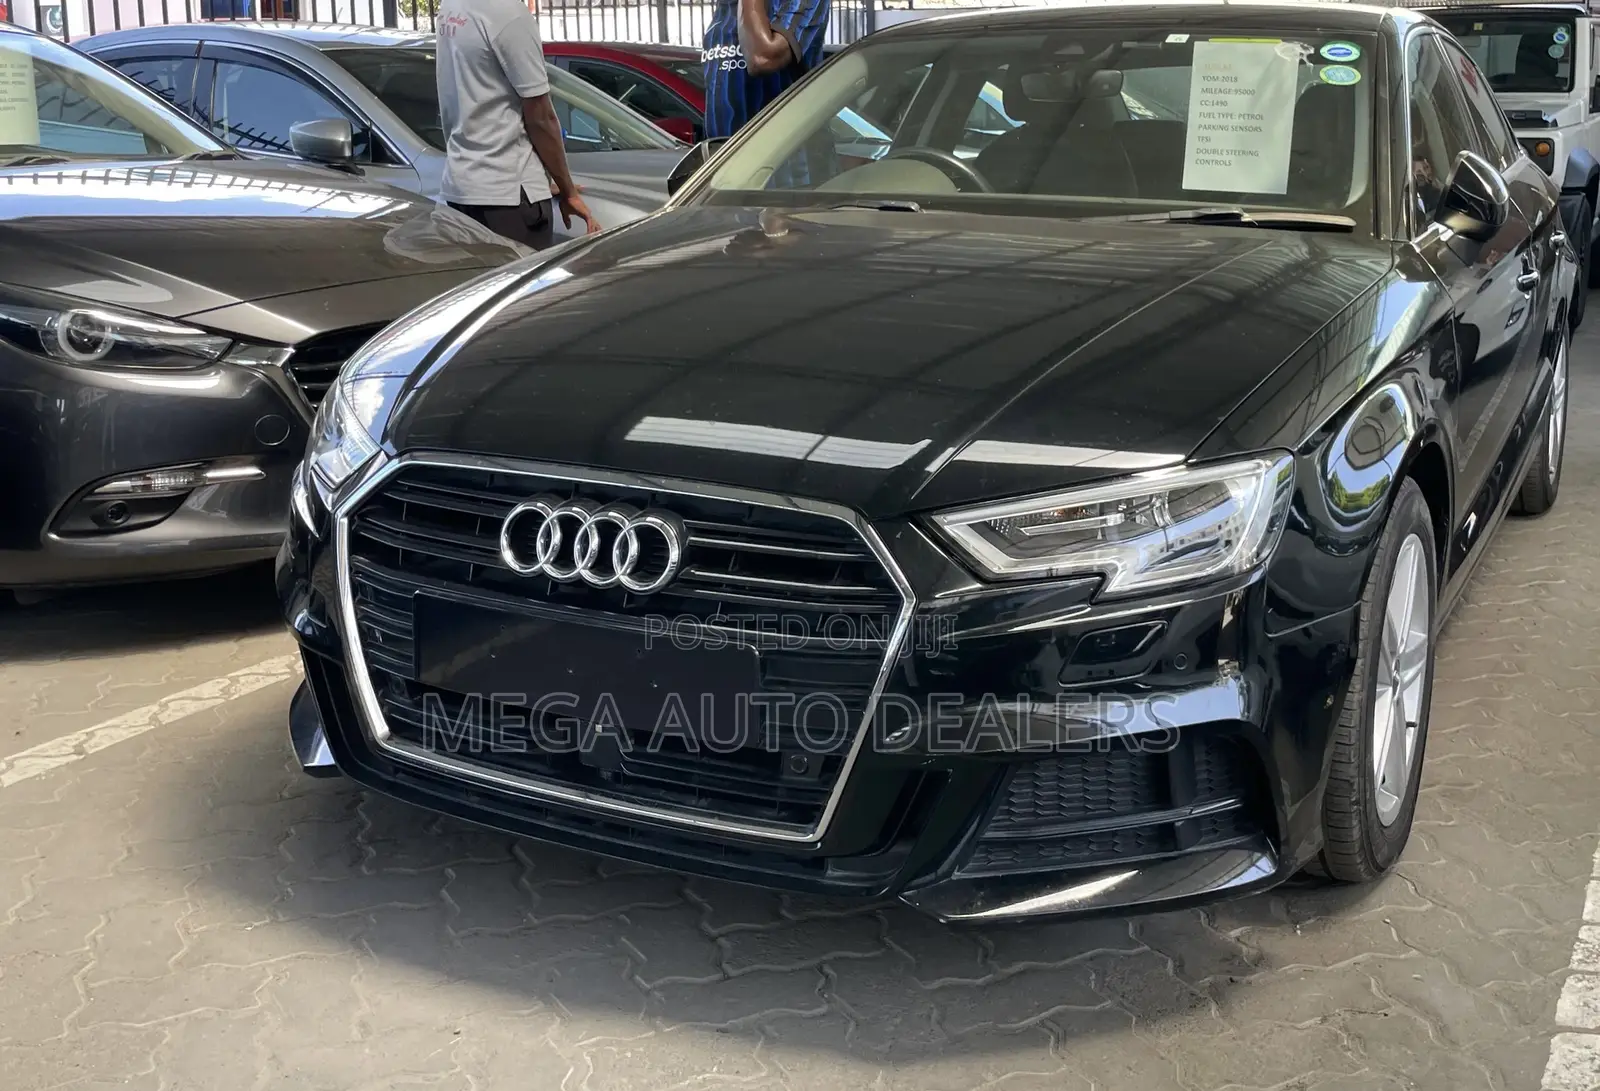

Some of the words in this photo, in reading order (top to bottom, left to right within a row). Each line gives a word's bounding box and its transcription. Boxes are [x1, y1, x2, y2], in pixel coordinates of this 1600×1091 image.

[1199, 111, 1216, 119] FUEL
[1238, 113, 1264, 121] PETROL
[1198, 123, 1229, 131] PARKING
[1230, 125, 1262, 133] SENSORS
[1196, 147, 1224, 156] DOUBLE
[1225, 149, 1260, 157] STEERING
[1195, 158, 1232, 167] CONTROLS
